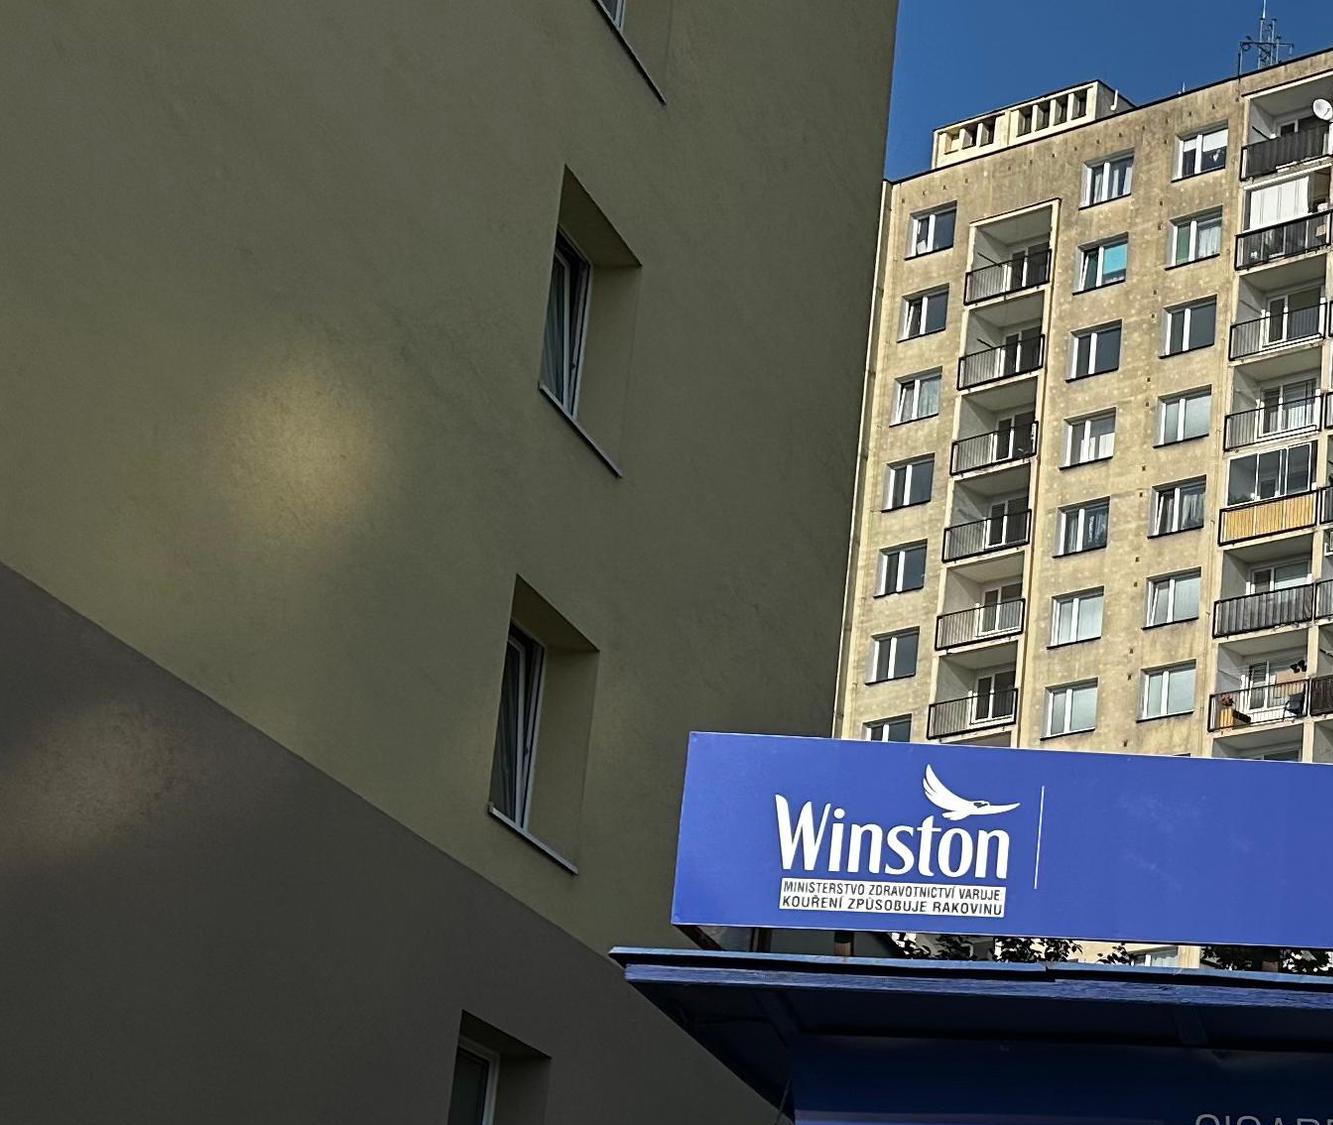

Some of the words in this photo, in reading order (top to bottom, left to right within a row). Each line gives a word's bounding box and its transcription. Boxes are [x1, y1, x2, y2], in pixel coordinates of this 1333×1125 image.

[775, 793, 1010, 879] Winston
[783, 880, 865, 896] MINISTERSTVO
[868, 883, 955, 899] ZDRAVOTNICTVÍ
[782, 895, 843, 909] KOUŘENÍ
[847, 897, 927, 913] ZPŮSOBUJE
[932, 901, 1003, 916] RAKOVINU
